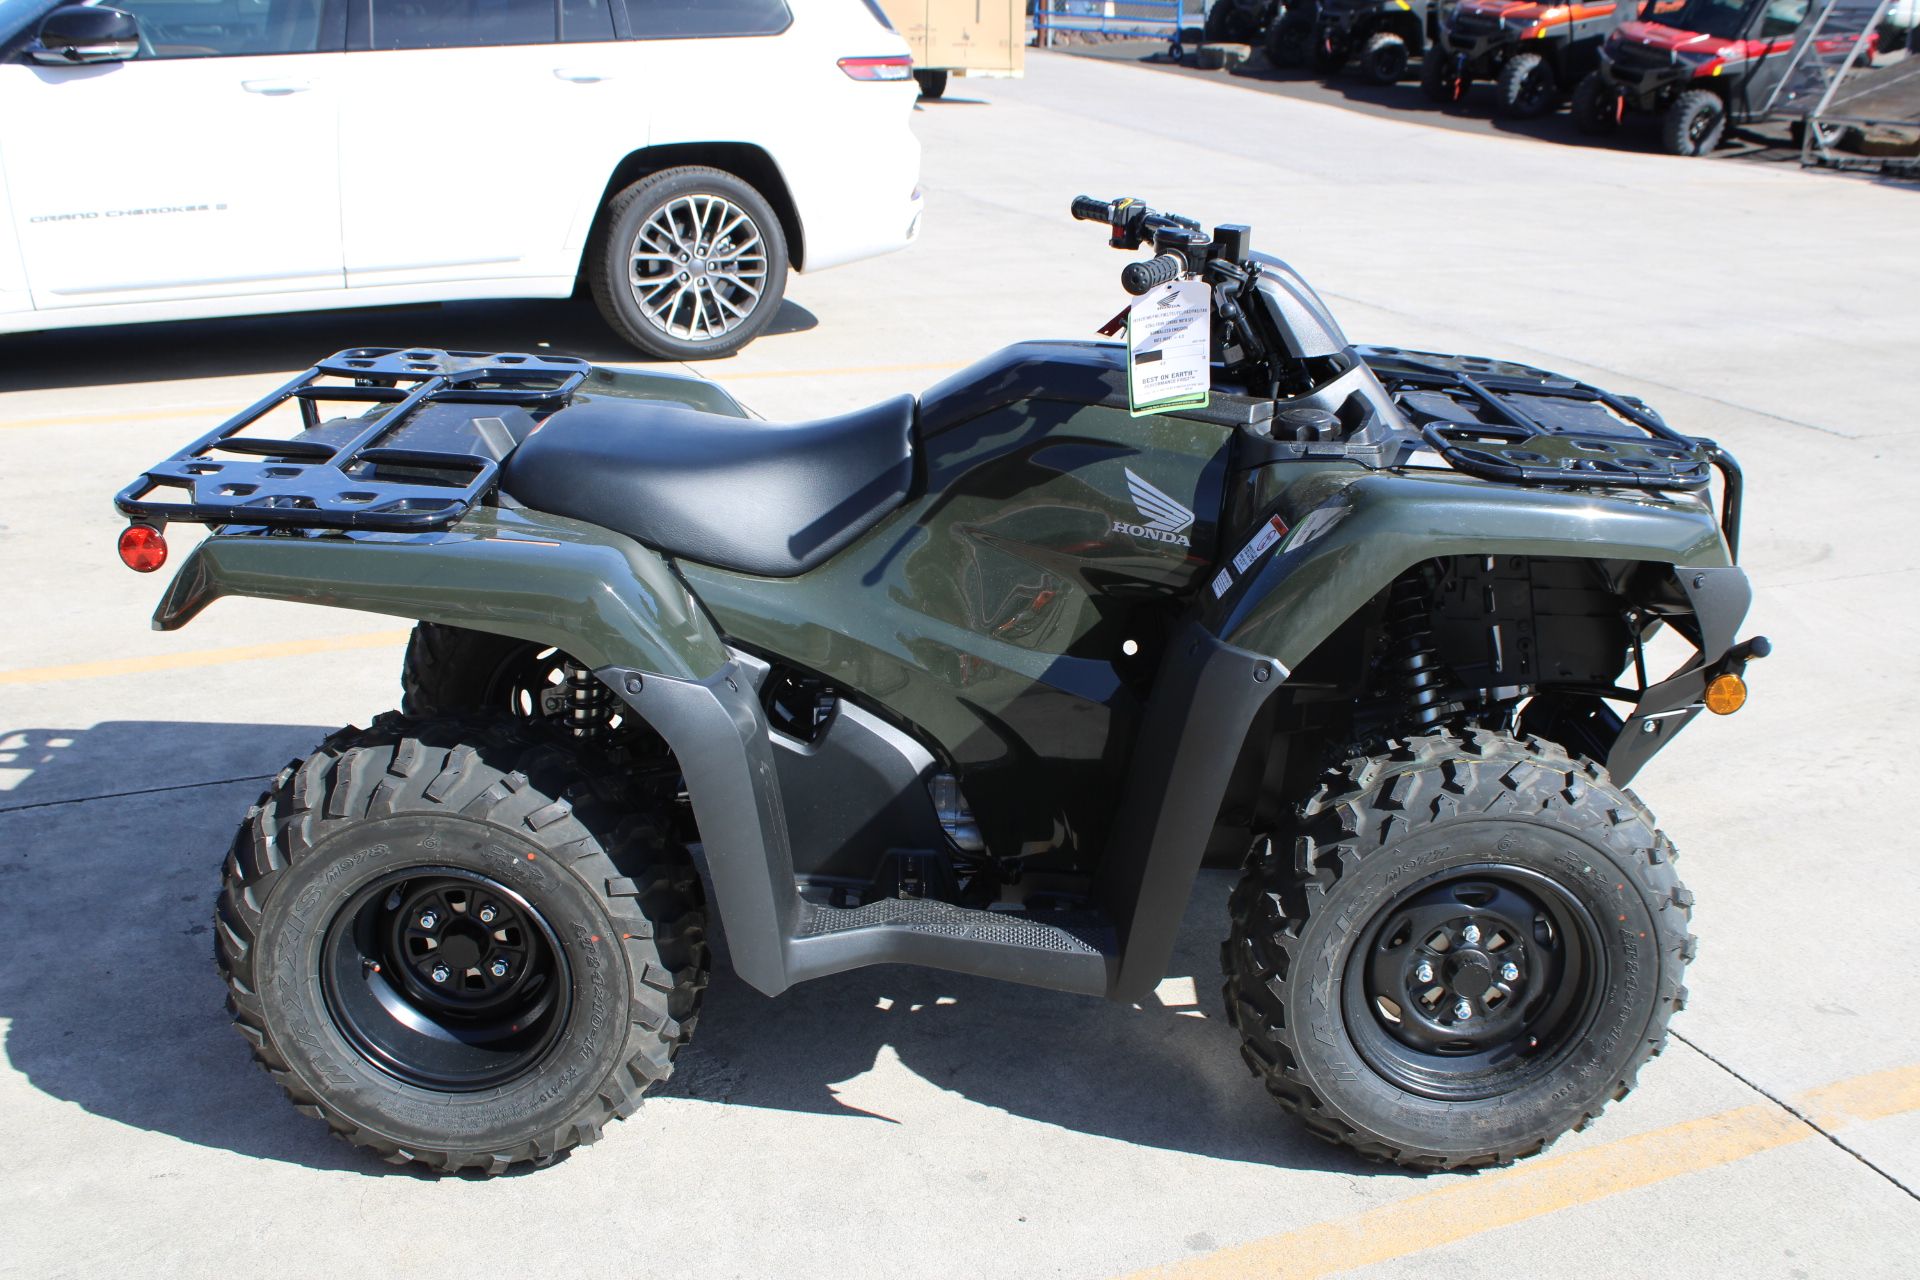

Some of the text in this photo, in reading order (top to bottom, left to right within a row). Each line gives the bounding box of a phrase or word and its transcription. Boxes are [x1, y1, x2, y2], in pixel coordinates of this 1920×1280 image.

[1142, 376, 1159, 385] BEST
[1171, 370, 1193, 379] EARTH
[1112, 521, 1192, 547] HONDA
[277, 881, 358, 1084] MAXXIS
